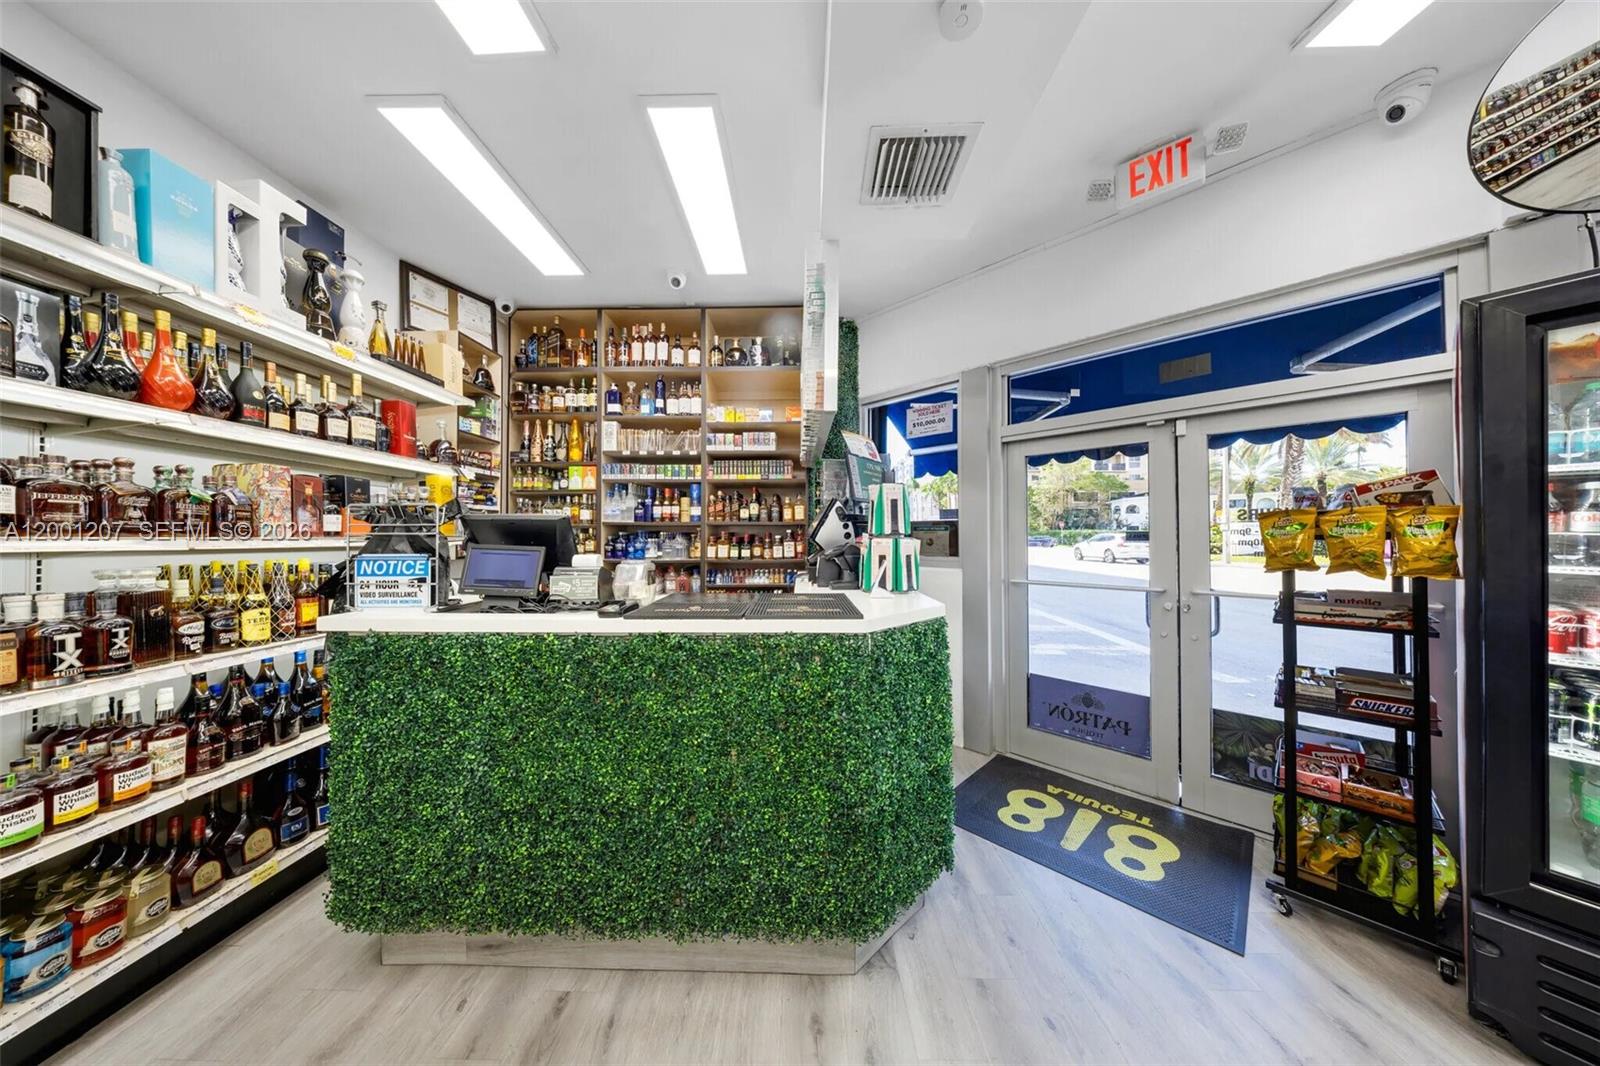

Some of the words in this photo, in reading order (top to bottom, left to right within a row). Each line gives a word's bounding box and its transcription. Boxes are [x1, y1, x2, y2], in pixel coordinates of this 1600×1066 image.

[1128, 136, 1193, 199] EXIT
[912, 417, 946, 428] $10,000.00
[1384, 473, 1422, 488] PACK
[359, 560, 426, 575] NOTICE
[359, 580, 370, 590] 24
[375, 580, 399, 590] HOUR
[1334, 597, 1382, 606] nutella
[1353, 699, 1414, 716] SNICKER
[118, 766, 149, 780] Hudson
[118, 770, 152, 786] Whiskey
[58, 785, 96, 801] Hudson
[118, 782, 133, 791] NY
[58, 791, 97, 807] Whiskey
[1046, 784, 1155, 828] TEQUILA
[0, 807, 35, 824] udson
[58, 803, 76, 813] NY
[0, 813, 37, 830] hiskey
[997, 789, 1181, 882] 818
